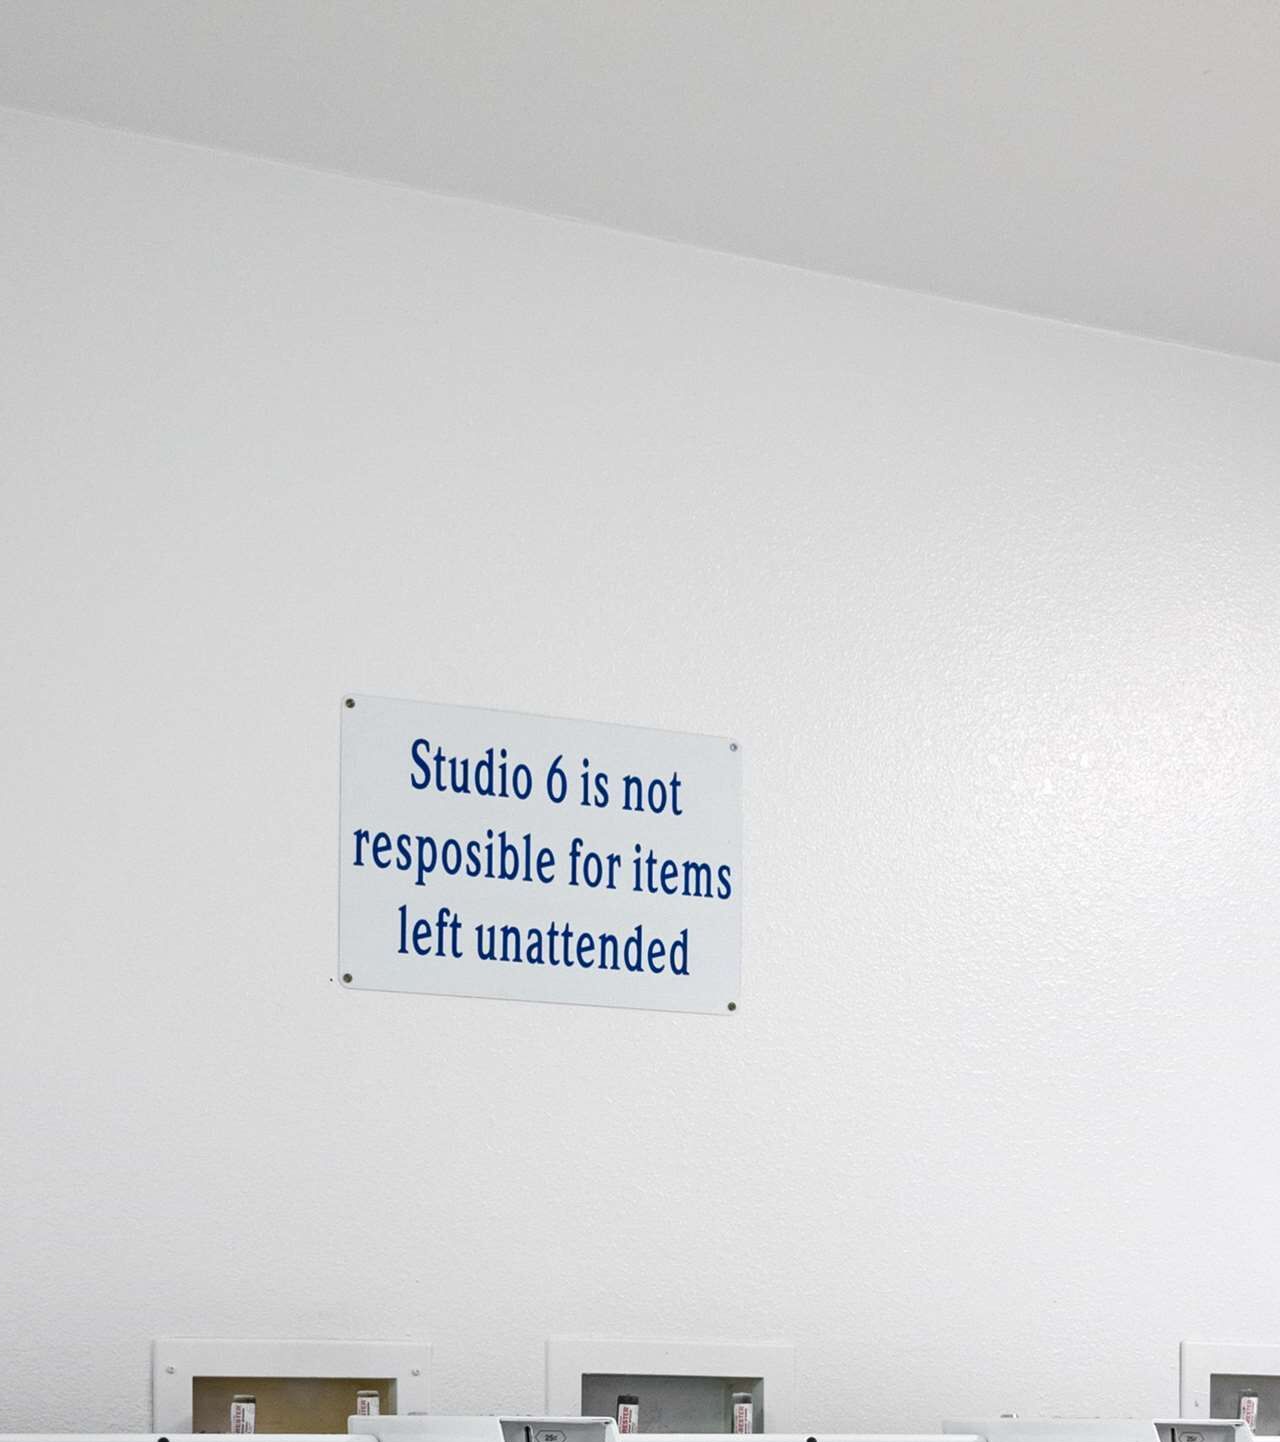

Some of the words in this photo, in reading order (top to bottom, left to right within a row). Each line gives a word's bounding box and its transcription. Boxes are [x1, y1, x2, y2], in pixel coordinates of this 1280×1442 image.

[411, 738, 532, 799] Studio
[547, 754, 567, 803] 6
[581, 759, 609, 808] is
[622, 772, 683, 816] not
[353, 829, 555, 885] resposible
[568, 838, 621, 889] for
[633, 844, 731, 900] items
[397, 905, 462, 958] left
[476, 921, 690, 976] unattended
